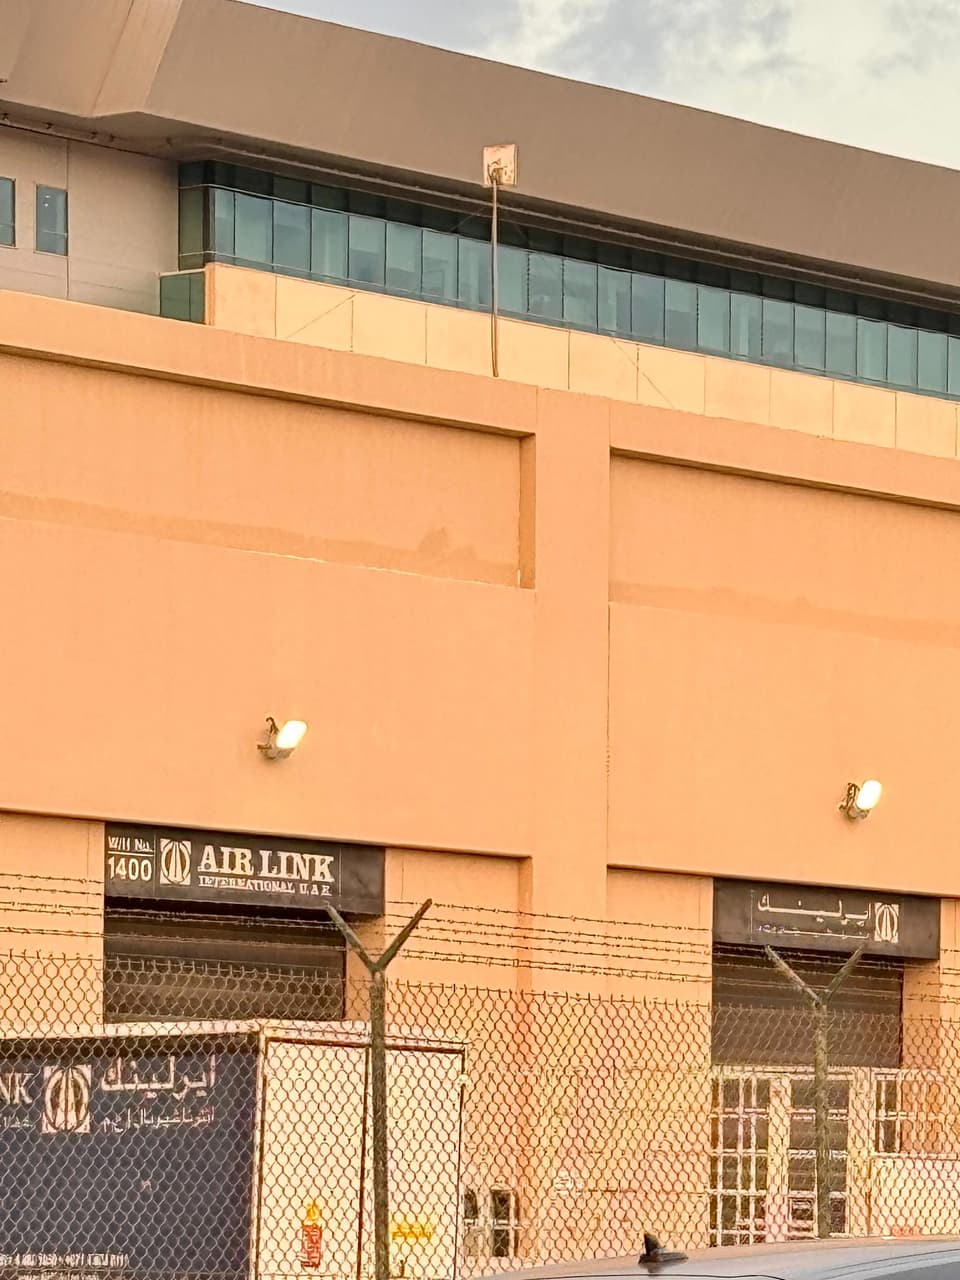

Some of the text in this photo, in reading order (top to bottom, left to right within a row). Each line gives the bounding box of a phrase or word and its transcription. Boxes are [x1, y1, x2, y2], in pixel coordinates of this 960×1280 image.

[108, 856, 152, 880] 1400
[197, 845, 335, 882] AIR LINK
